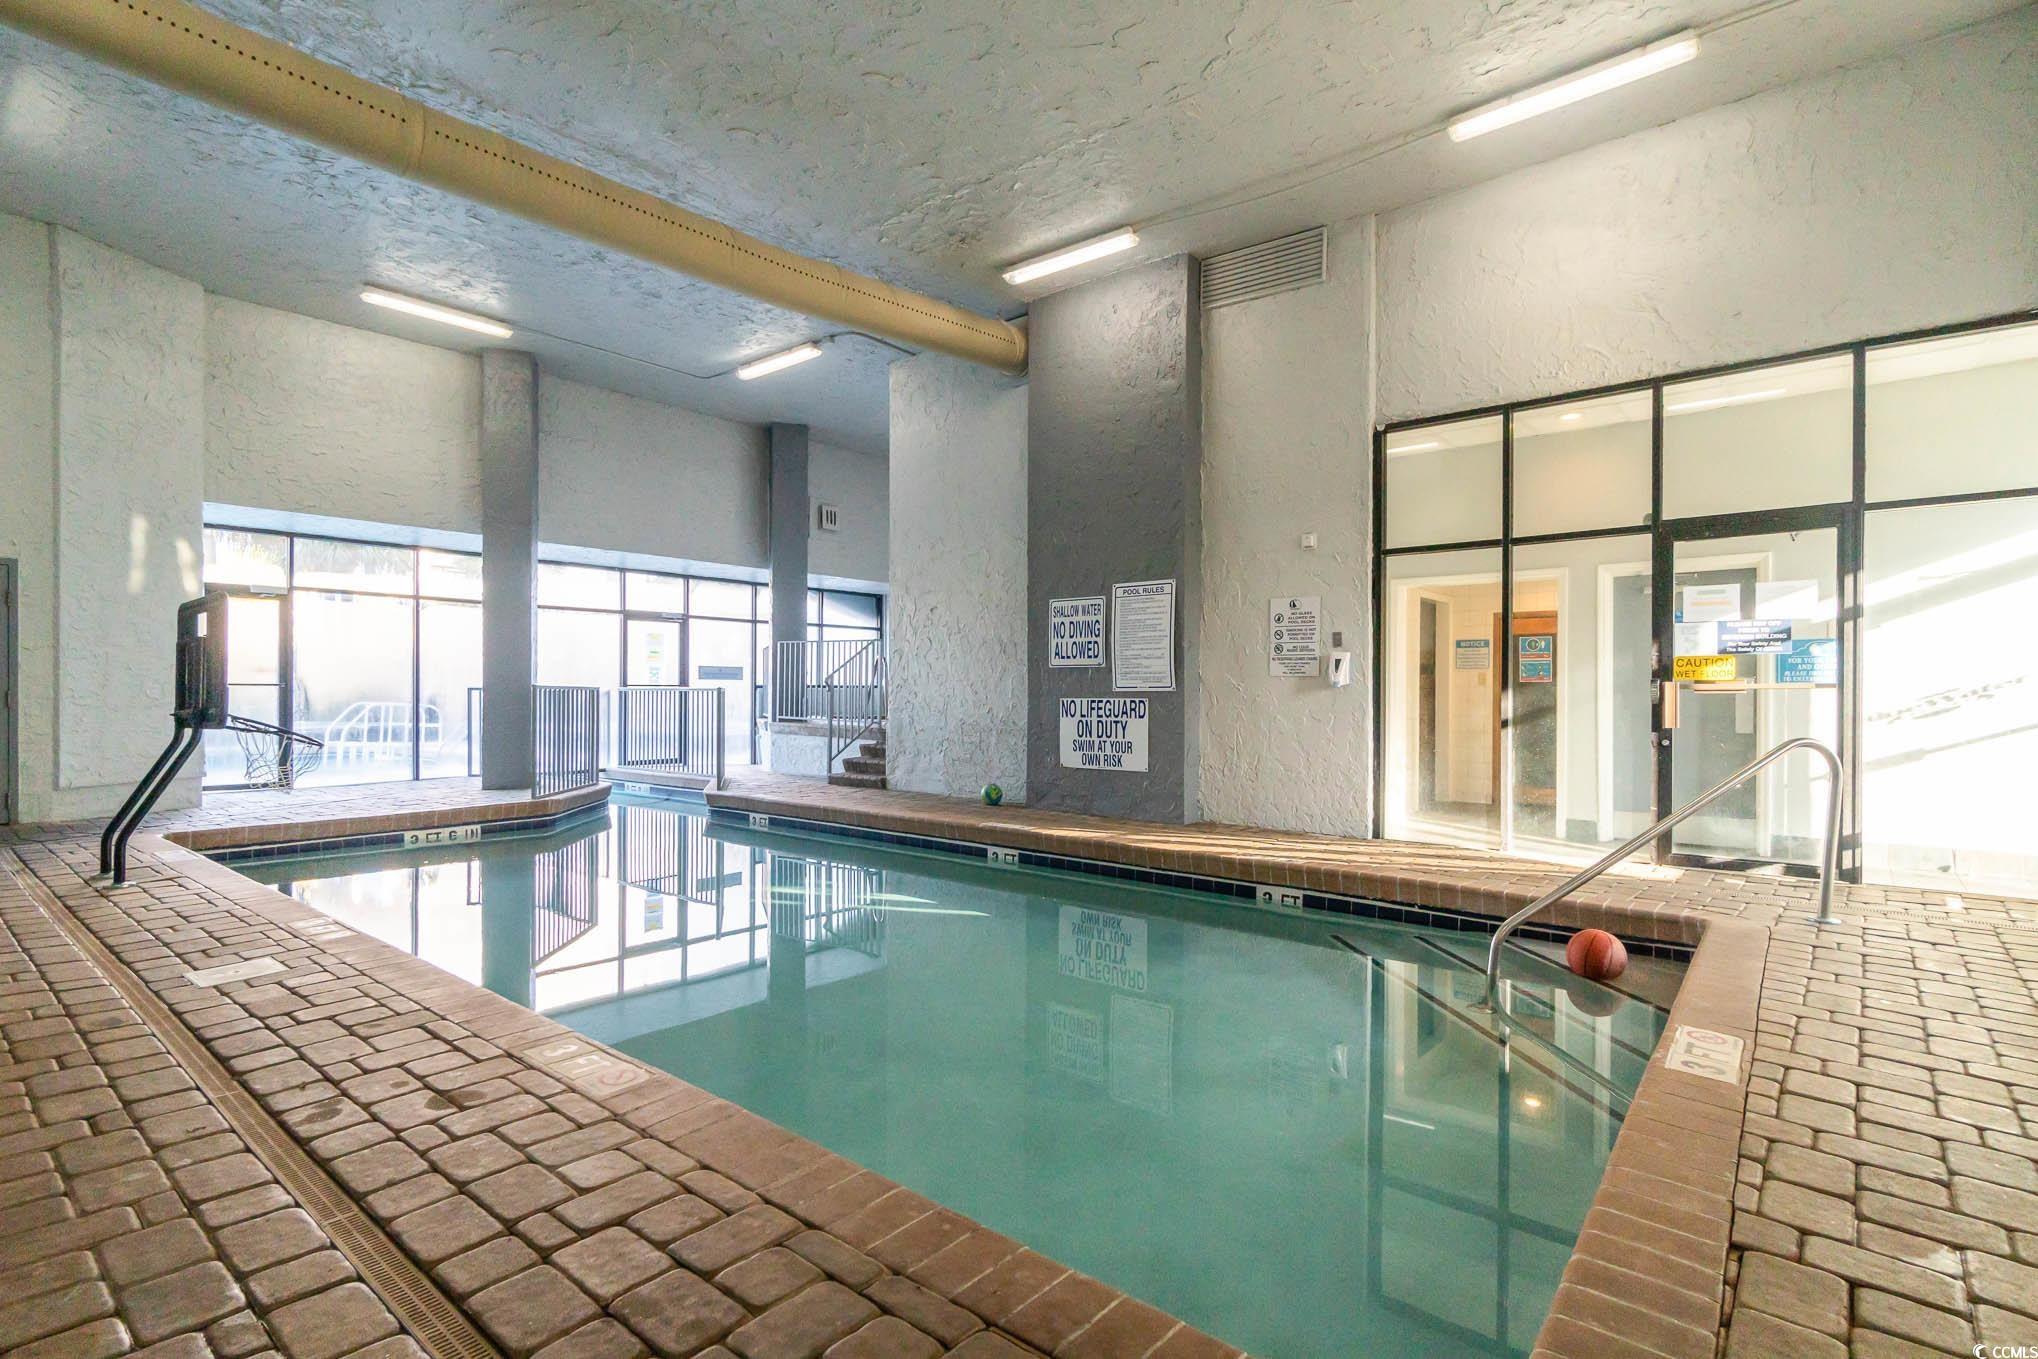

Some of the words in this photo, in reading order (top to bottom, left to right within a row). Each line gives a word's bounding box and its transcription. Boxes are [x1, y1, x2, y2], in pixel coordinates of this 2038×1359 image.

[1053, 605, 1079, 618] SHALLOW
[1081, 604, 1102, 616] WATER
[1053, 623, 1066, 639] NO
[1069, 620, 1101, 639] DIVING
[1054, 640, 1100, 660] ALLOWED
[1676, 658, 1733, 668] CAUTION
[1062, 700, 1077, 717] NO
[1080, 700, 1146, 719] LIFEGUARD
[1077, 720, 1093, 738] ON
[1097, 720, 1128, 739] DUTY
[1072, 740, 1095, 753] SWIM
[1097, 740, 1107, 752] AT
[1109, 740, 1133, 754] YOUR
[1081, 752, 1100, 766] OWN
[1104, 754, 1122, 767] RISK
[410, 835, 419, 844] 3
